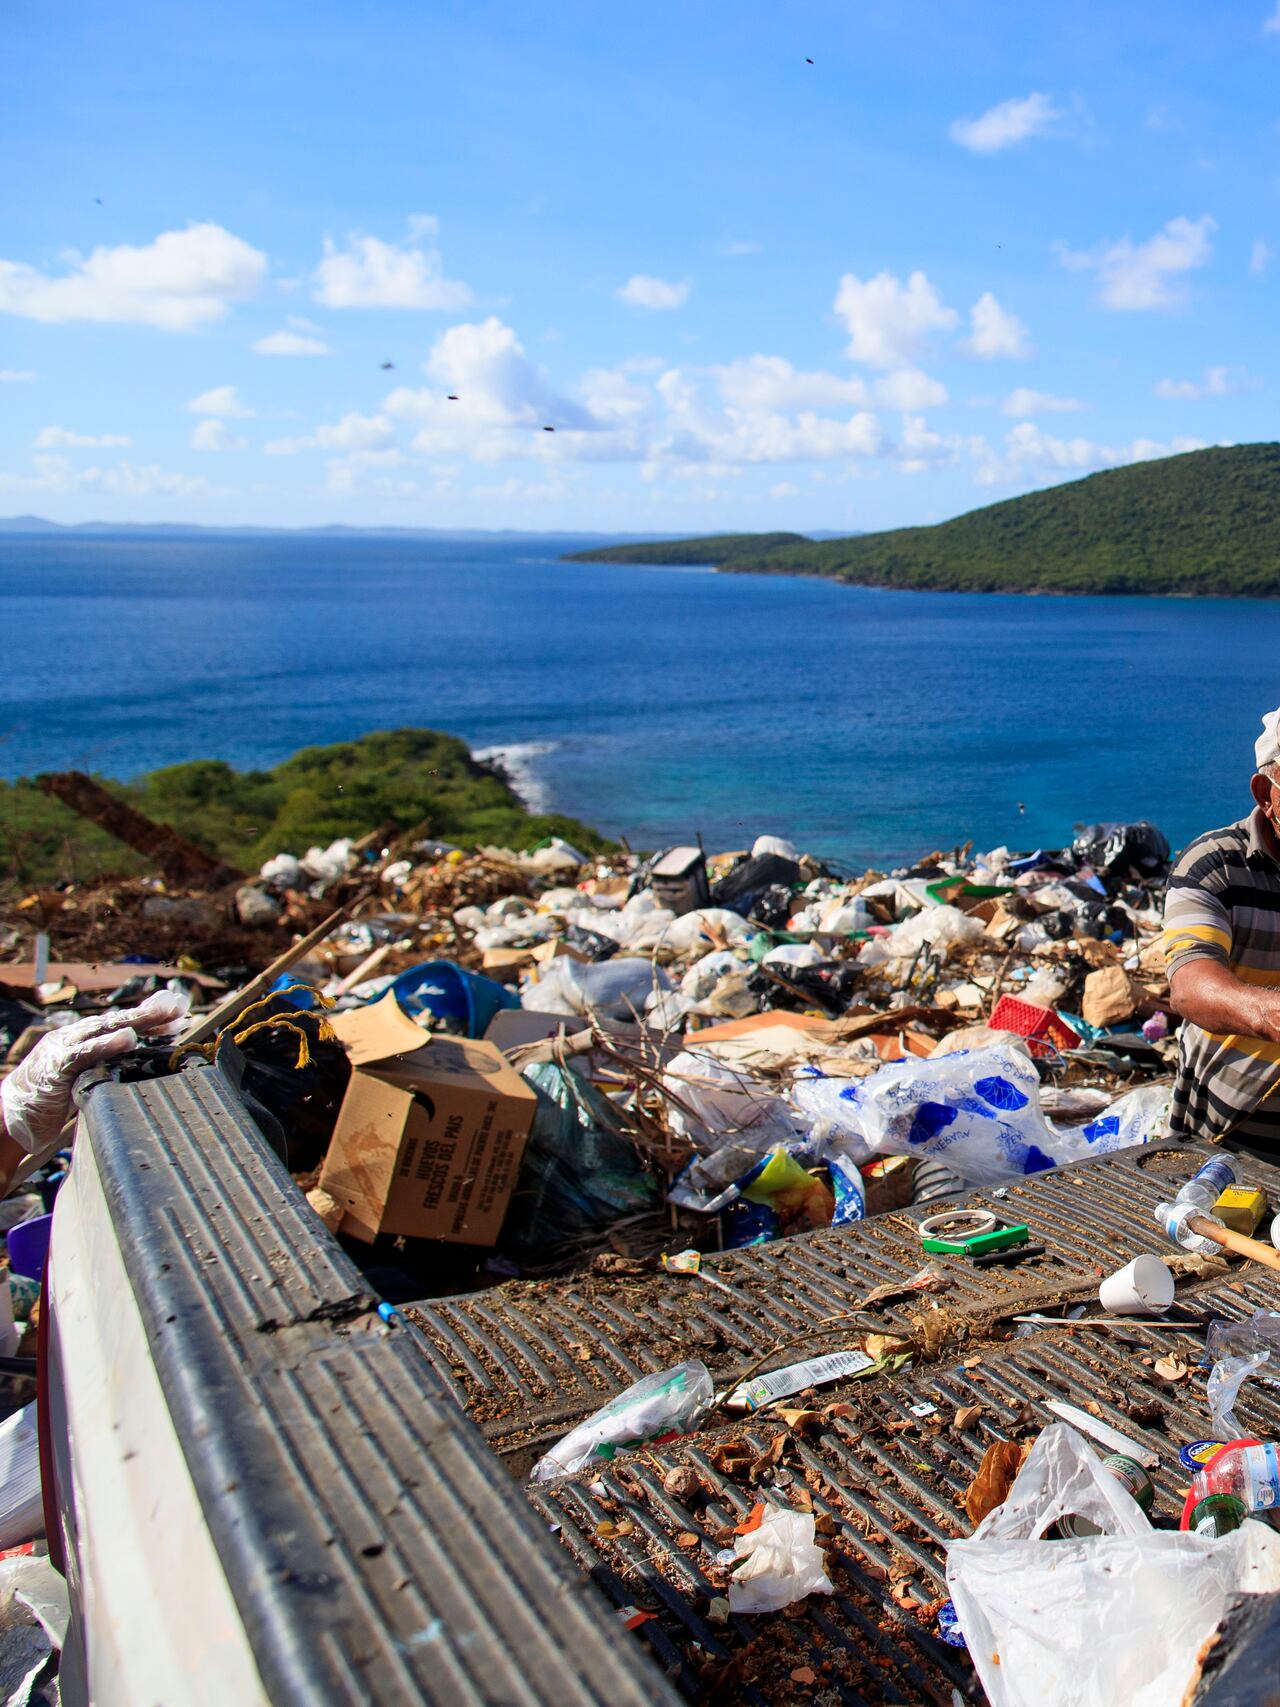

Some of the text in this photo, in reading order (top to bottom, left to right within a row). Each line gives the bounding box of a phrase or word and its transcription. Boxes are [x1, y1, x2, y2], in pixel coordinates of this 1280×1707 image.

[416, 1139, 440, 1180] HUEVOS
[424, 1114, 464, 1209] FRESCOS DEL PAIS
